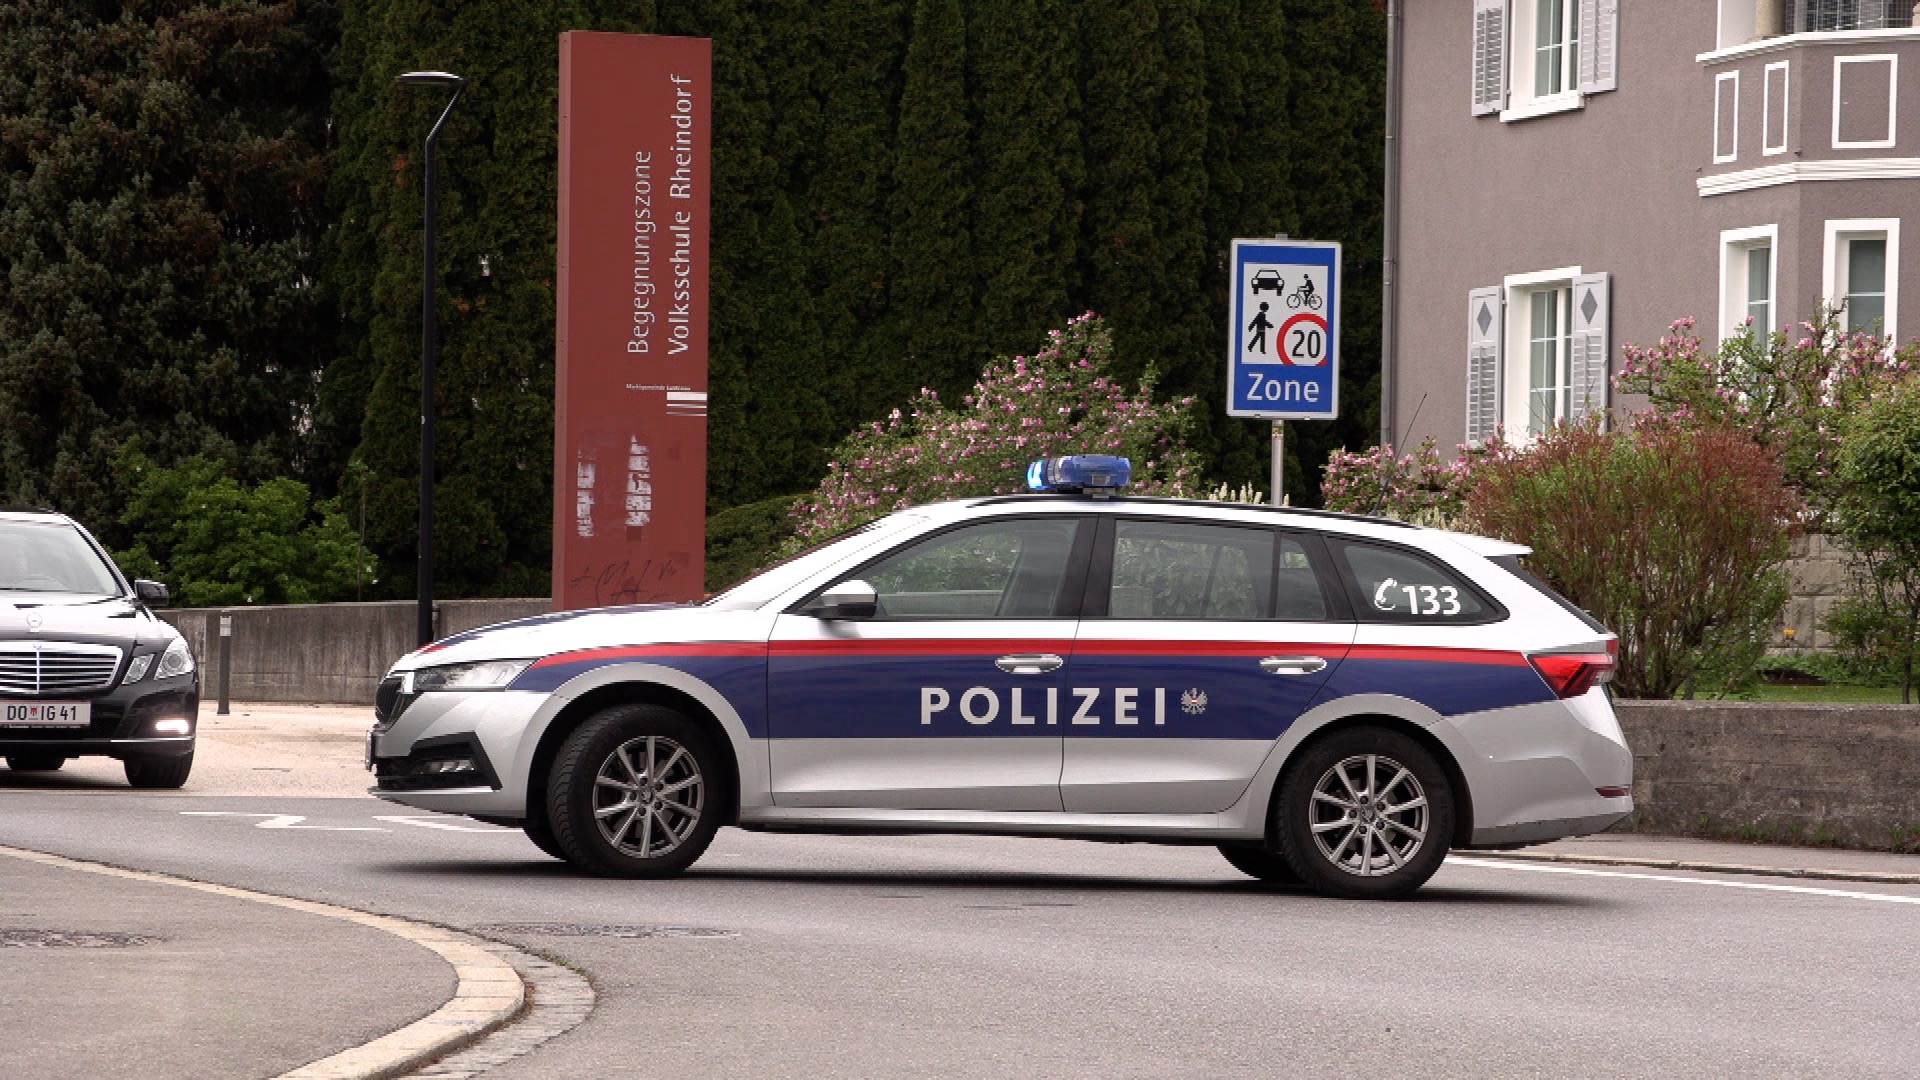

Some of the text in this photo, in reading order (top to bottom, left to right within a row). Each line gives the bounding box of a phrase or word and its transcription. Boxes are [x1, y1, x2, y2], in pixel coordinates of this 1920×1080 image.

[667, 73, 692, 355] Volksschule Rheindorf
[627, 150, 656, 354] Begegnungszone
[1292, 330, 1321, 358] 20
[1247, 373, 1320, 402] Zone
[1402, 585, 1461, 616] 133
[7, 705, 27, 720] DO
[60, 705, 76, 720] 41
[921, 687, 1166, 725] POLIZEI
